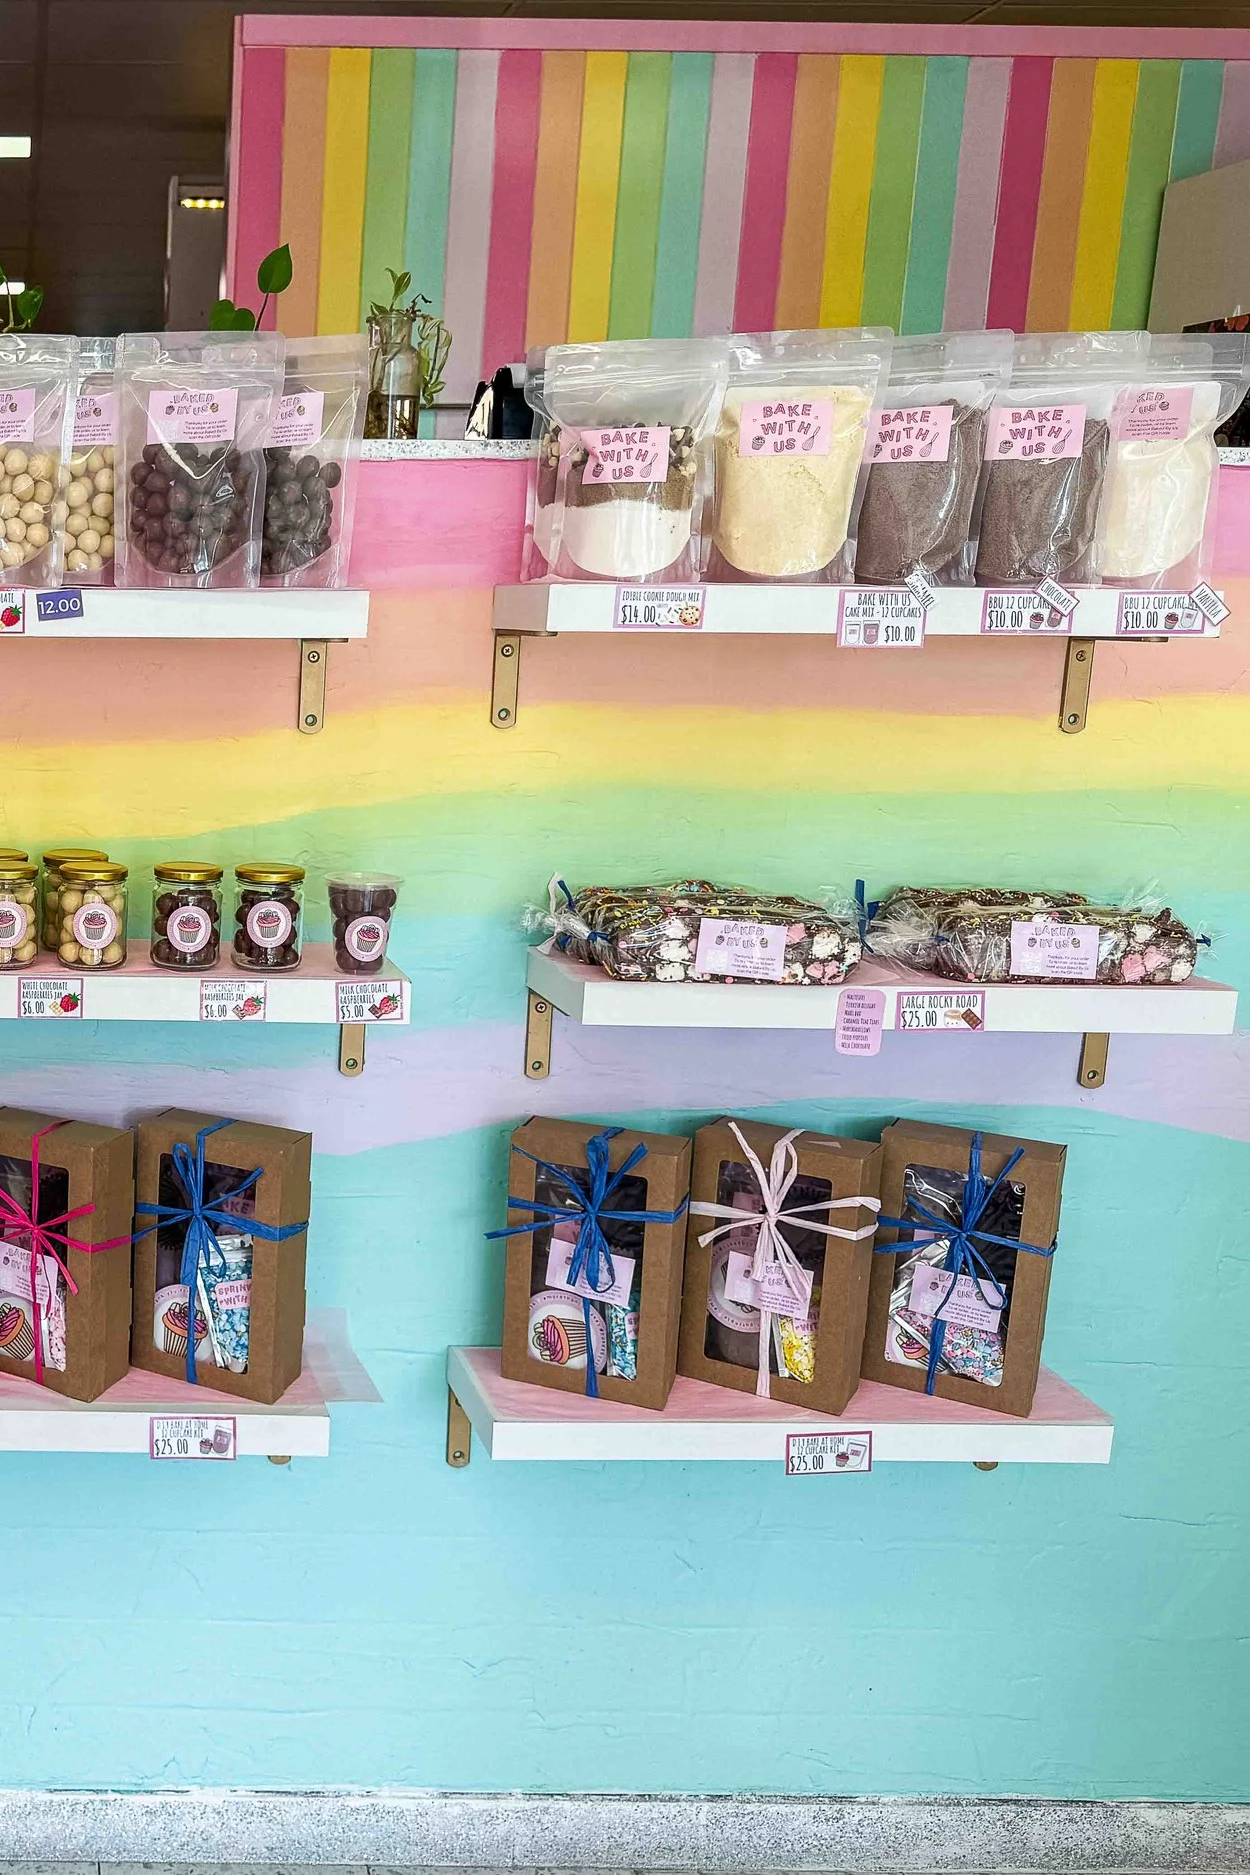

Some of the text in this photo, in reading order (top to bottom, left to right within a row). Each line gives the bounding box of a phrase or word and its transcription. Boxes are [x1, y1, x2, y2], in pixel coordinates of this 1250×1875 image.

[763, 403, 812, 418] BAKE
[881, 410, 931, 426] BAKE
[1011, 409, 1063, 424] BAKE
[761, 420, 811, 436] WITH
[878, 427, 929, 443] WITH
[1009, 425, 1062, 441] WITH
[600, 430, 649, 446] BAKE
[773, 437, 796, 453] US
[599, 448, 649, 463] WITH
[890, 445, 913, 460] US
[1021, 442, 1045, 457] US
[612, 465, 634, 480] US
[622, 590, 700, 602] EDIBLE COOKIE DOUGH MIX
[857, 593, 911, 606] BAKE WITH US
[988, 596, 1004, 609] BBU
[1006, 596, 1015, 609] 12
[1040, 581, 1073, 611] CHOCOLATE
[1124, 597, 1139, 610] BBU
[1141, 597, 1150, 610] 12
[1153, 596, 1185, 610] CUPCAKE
[1195, 588, 1223, 619] VANILLA
[38, 597, 81, 615] 12.00
[845, 607, 921, 618] CAKE MIX 12 CUPCAKES
[621, 605, 656, 624] $14.00
[988, 610, 1023, 630] $10.00
[1124, 610, 1159, 631] $10.00
[884, 625, 916, 643] $10.00
[22, 981, 68, 990] WHITE CHOCOLATE
[340, 983, 388, 995] MILK CHOCOLATE
[22, 991, 53, 999] RASPBERRIES
[204, 993, 234, 1001] RASPBERRIES
[340, 994, 375, 1004] RASPBERRIES
[901, 995, 978, 1009] LARGE ROCKY ROAD
[22, 1001, 45, 1015] $6.00
[204, 1004, 227, 1018] $6.00
[340, 1005, 364, 1019] $5.00
[901, 1010, 937, 1030] $25.00
[155, 1439, 188, 1456] $25.00
[805, 1446, 828, 1455] CUPCAKE
[790, 1455, 823, 1473] $25.00
